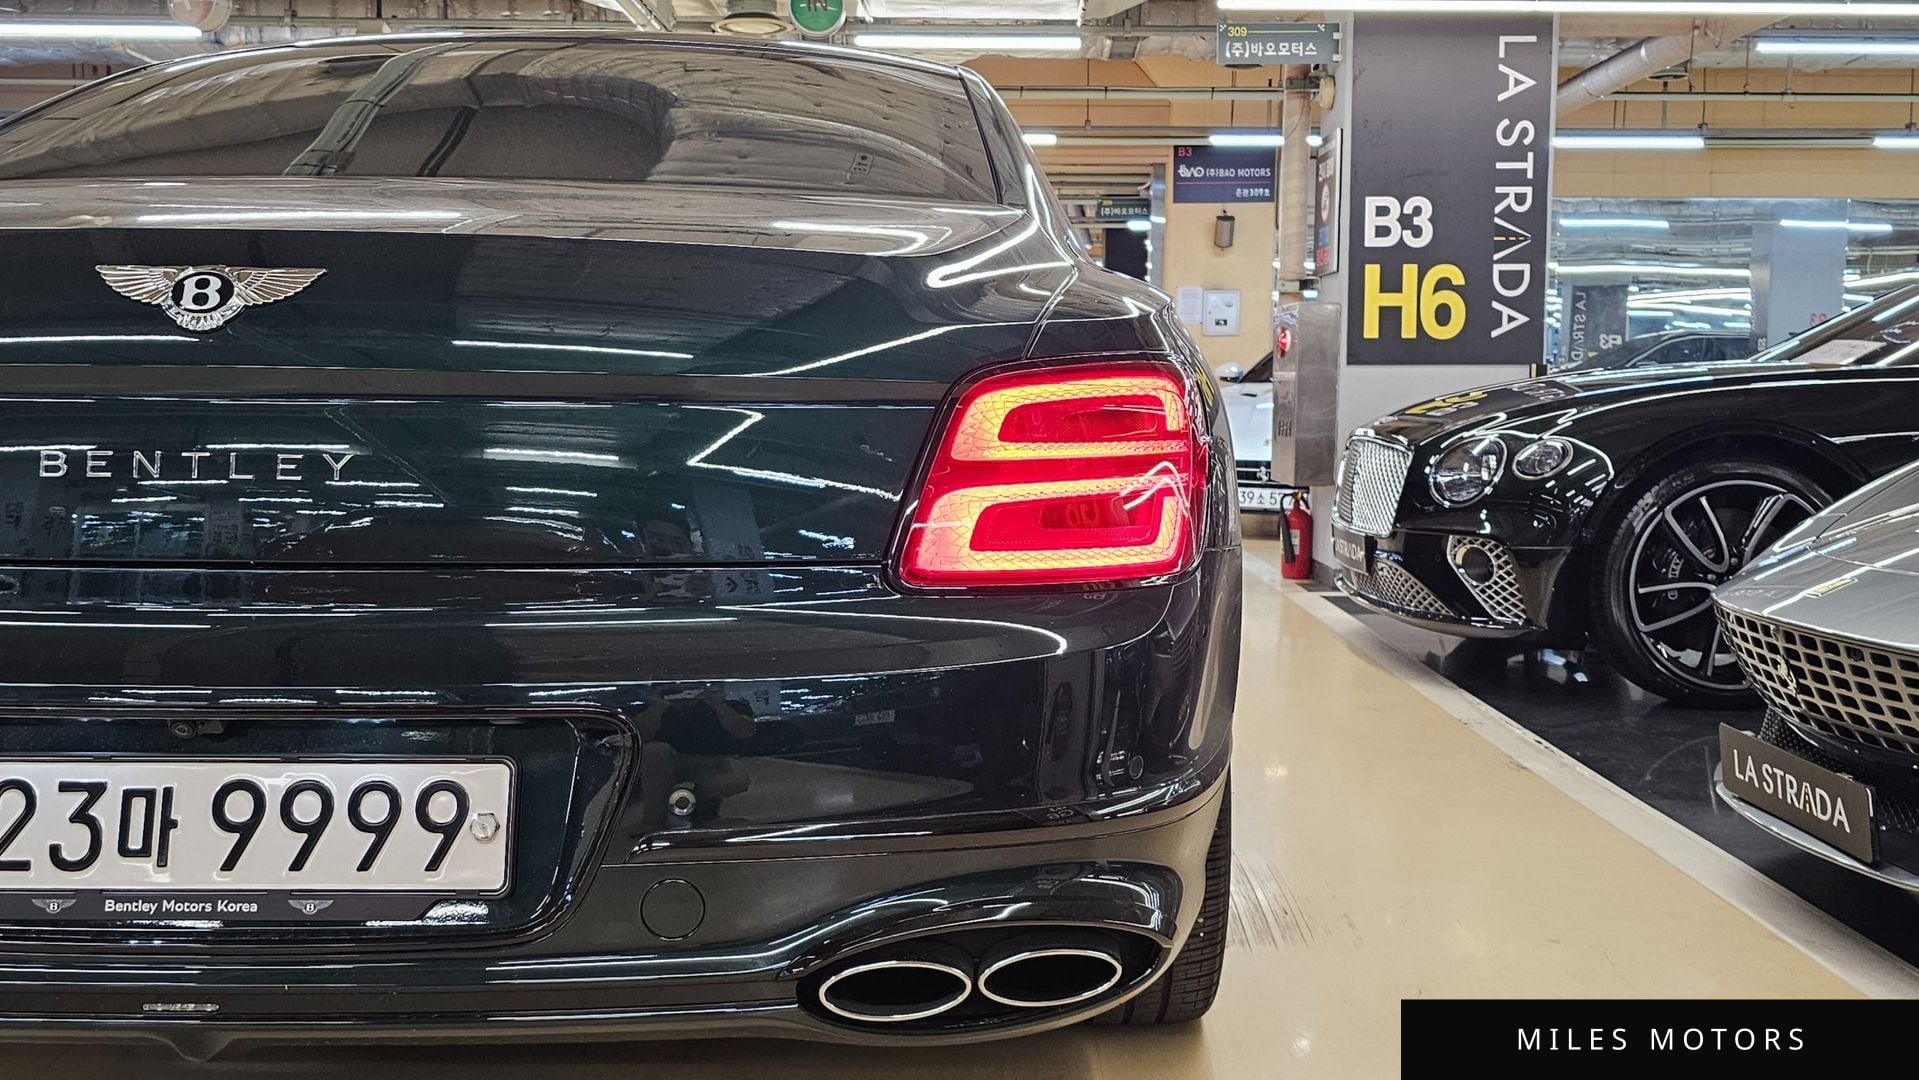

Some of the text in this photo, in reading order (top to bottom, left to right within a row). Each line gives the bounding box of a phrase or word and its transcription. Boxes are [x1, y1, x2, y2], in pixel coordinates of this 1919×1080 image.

[1227, 26, 1247, 37] 309
[1225, 41, 1317, 59] (주)바오모터스
[1178, 147, 1192, 157] B3
[1237, 168, 1271, 177] MOTORS
[1490, 35, 1538, 339] LA STRADA
[1363, 196, 1433, 249] B3
[181, 274, 222, 311] B
[1363, 263, 1466, 340] H6
[39, 450, 356, 481] BENTLEY
[1733, 749, 1851, 834] LA STRADA
[211, 778, 471, 872] 9999
[104, 898, 258, 916] Bentley Motors Korea
